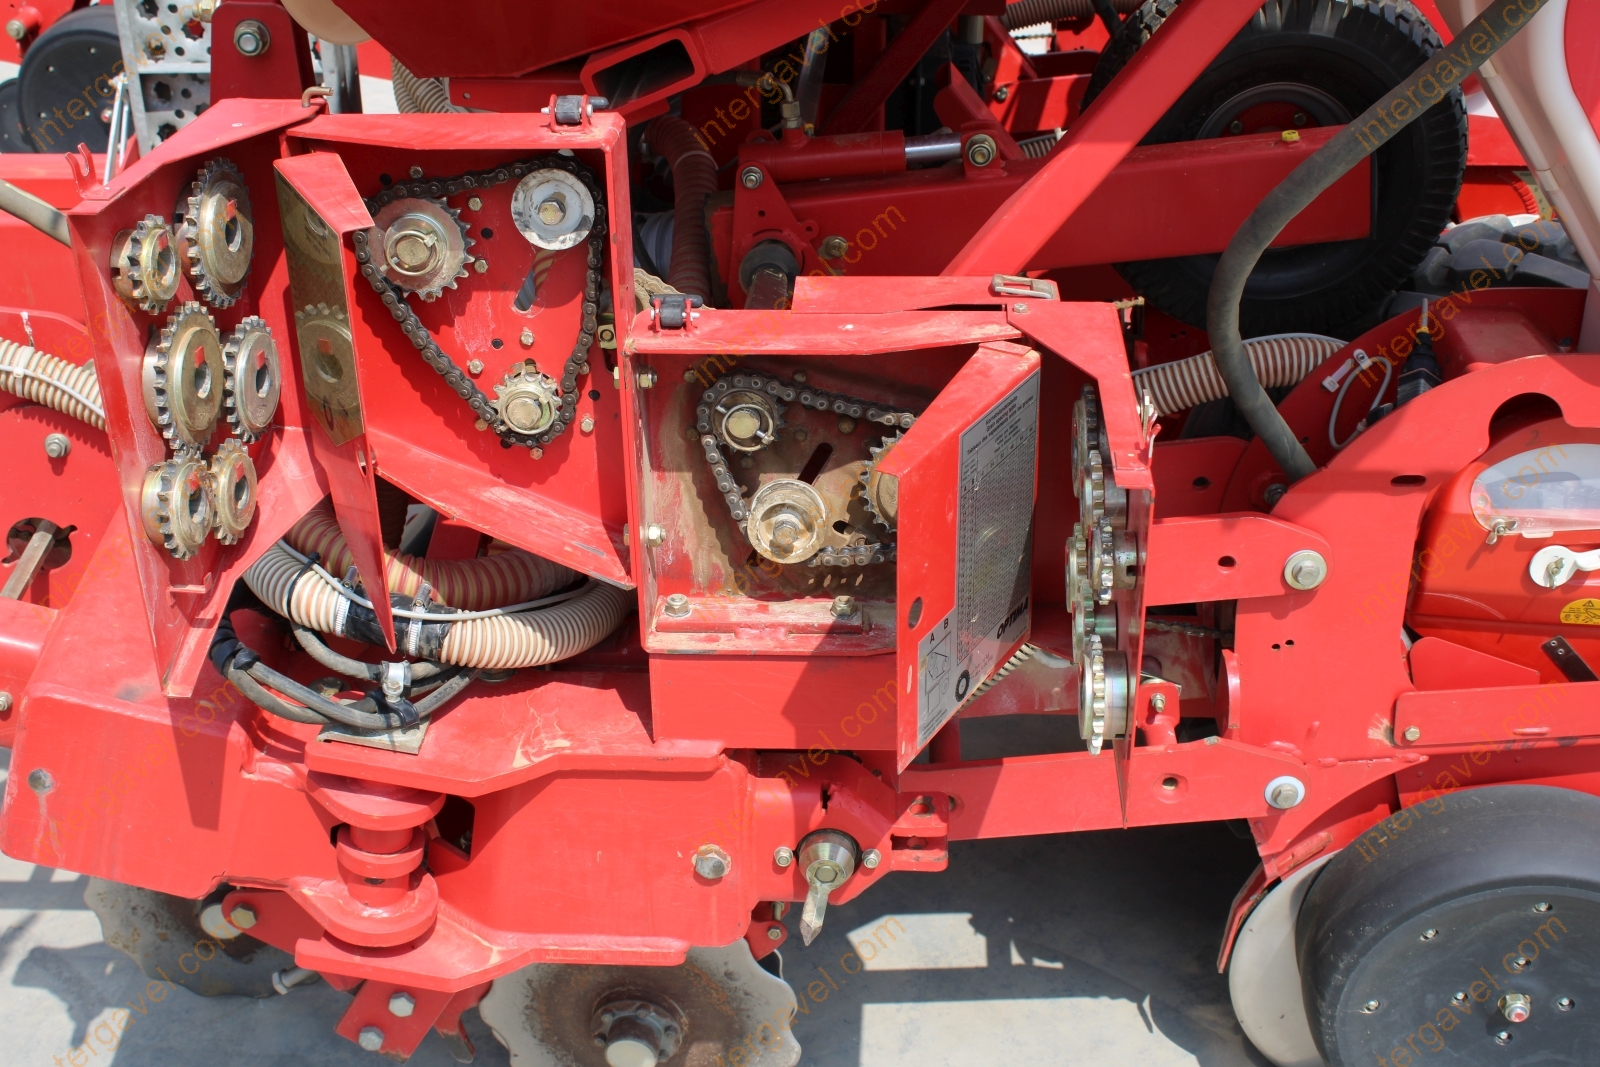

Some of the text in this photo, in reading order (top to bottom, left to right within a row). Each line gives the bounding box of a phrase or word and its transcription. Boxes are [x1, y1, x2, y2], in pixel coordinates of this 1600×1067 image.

[930, 618, 949, 644] A B
[996, 596, 1028, 639] OPTIMA
